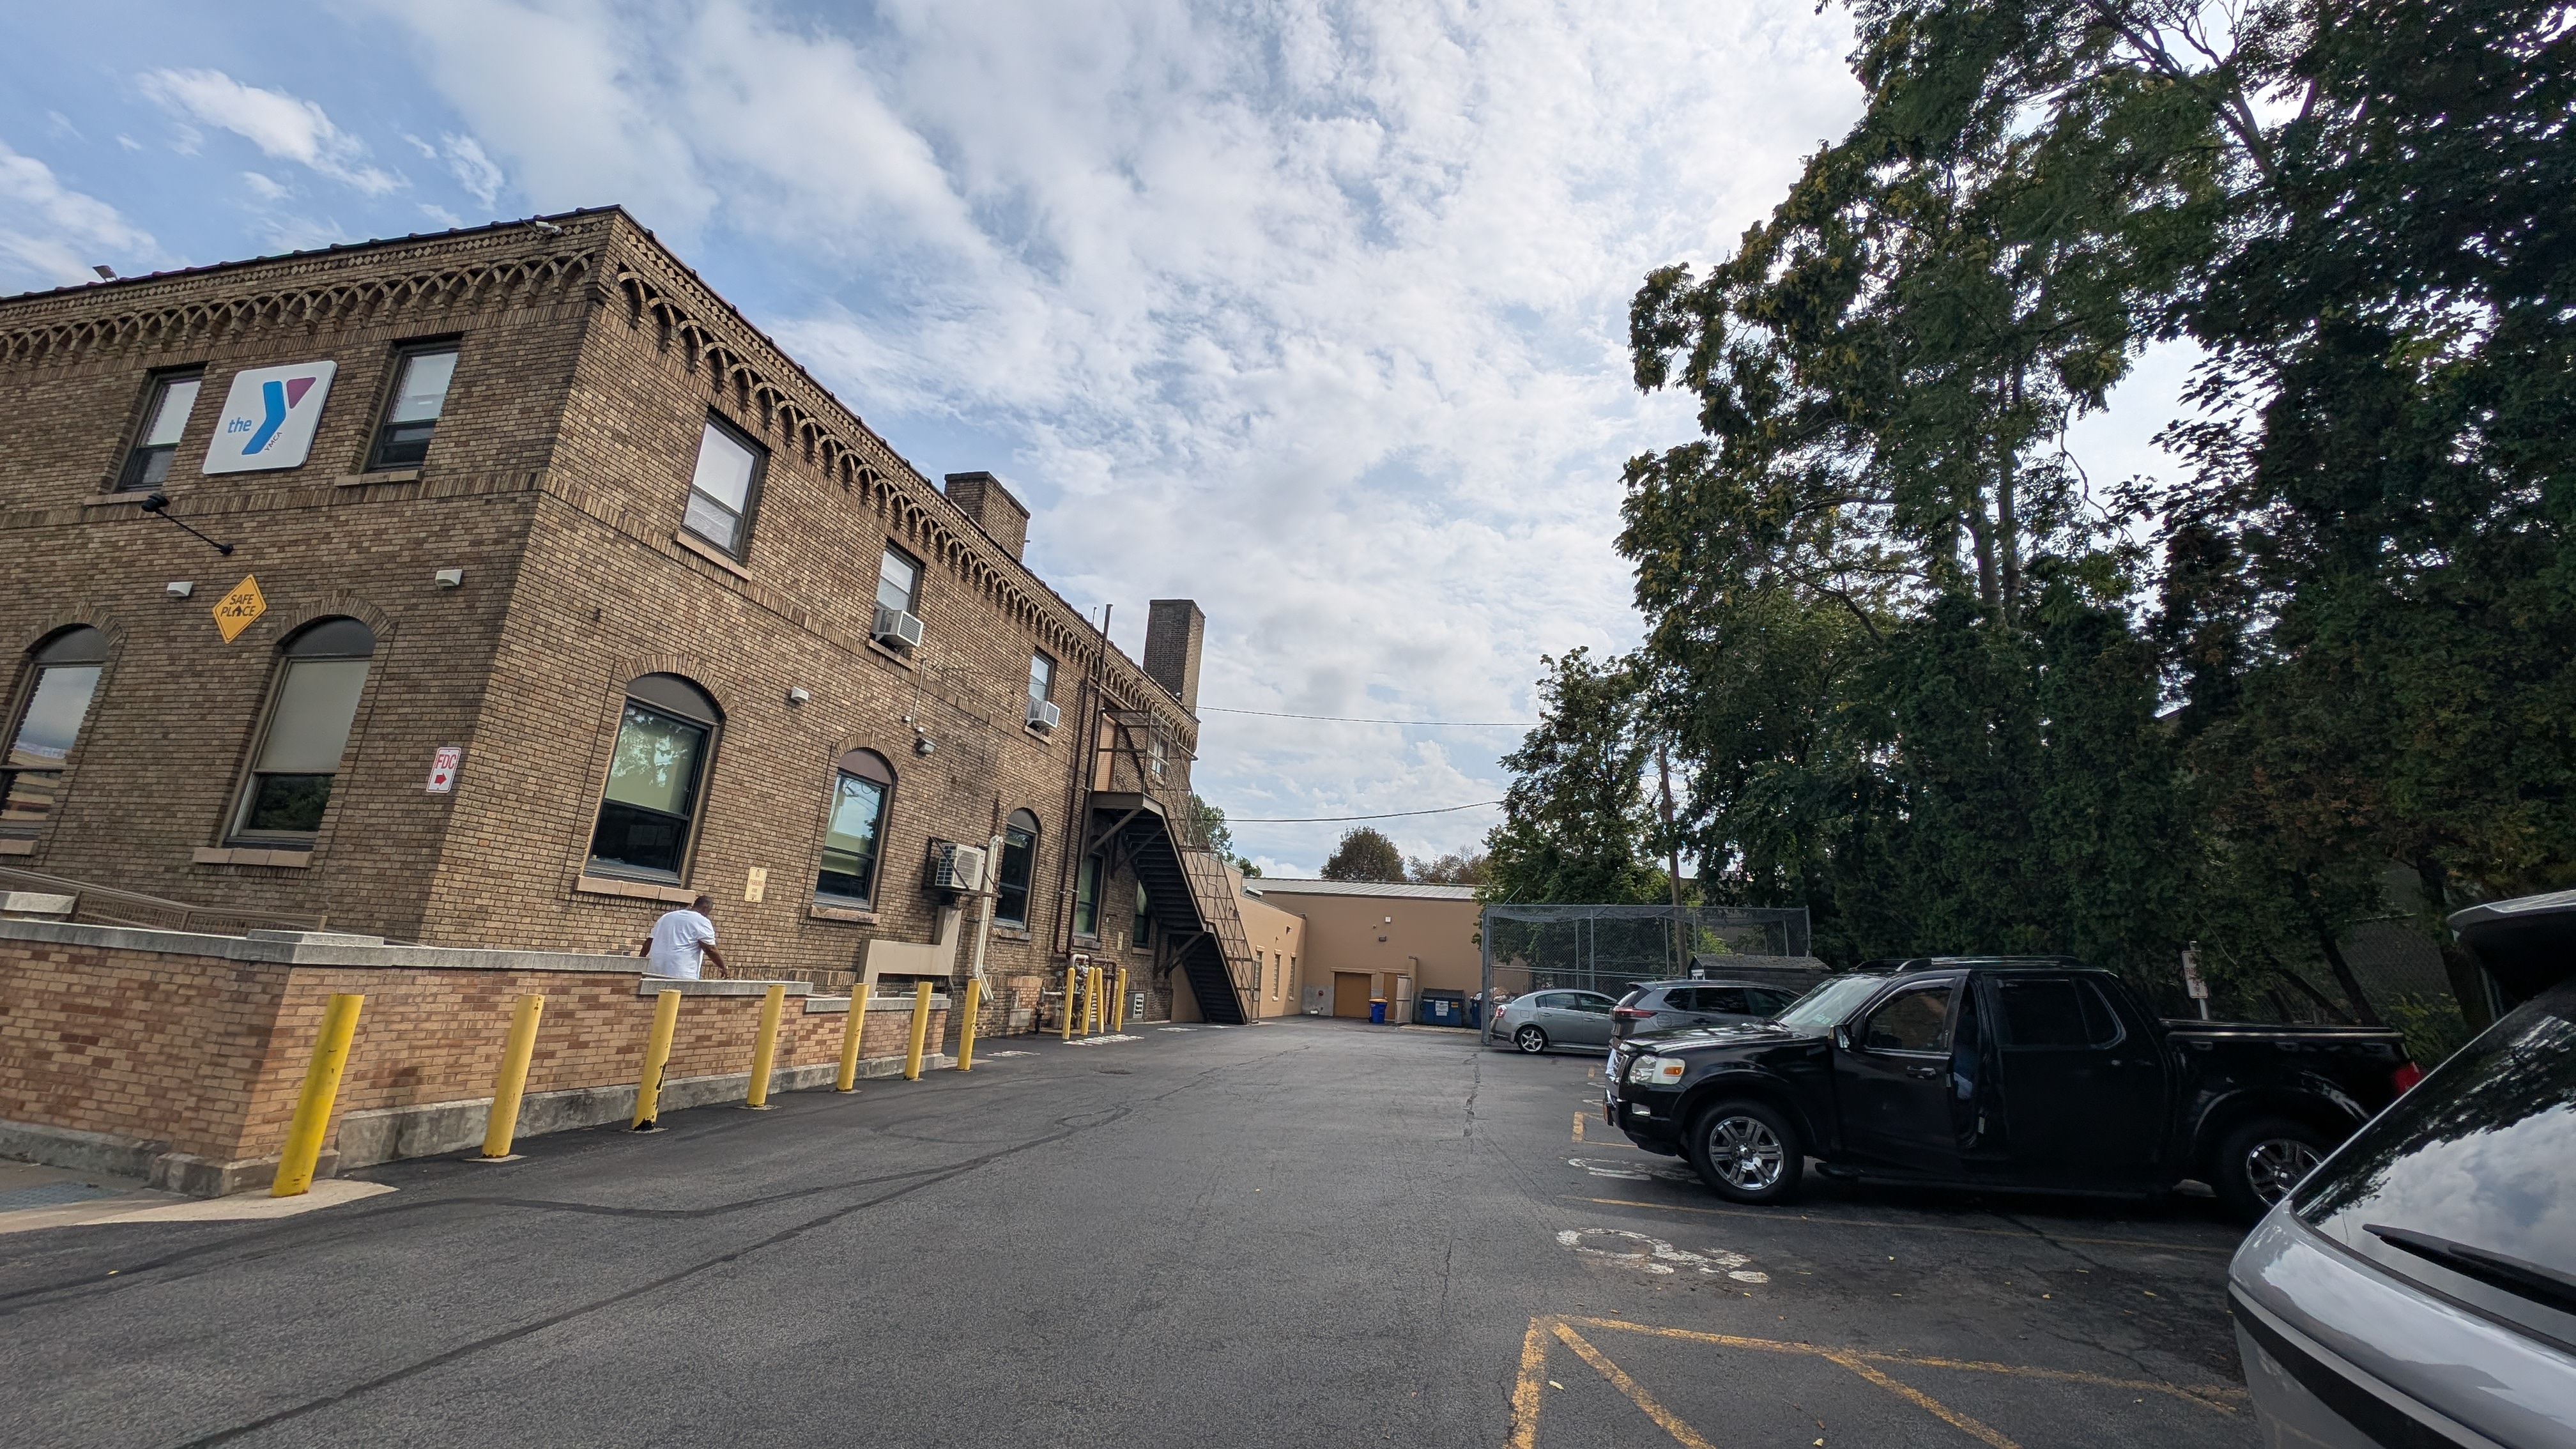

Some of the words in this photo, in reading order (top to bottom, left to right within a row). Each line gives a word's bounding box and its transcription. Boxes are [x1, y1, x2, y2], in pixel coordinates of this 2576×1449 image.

[227, 417, 252, 433] the
[264, 432, 282, 451] YMCA
[229, 594, 254, 605] SAFE
[220, 605, 256, 617] PLACE
[435, 755, 456, 769] FDC
